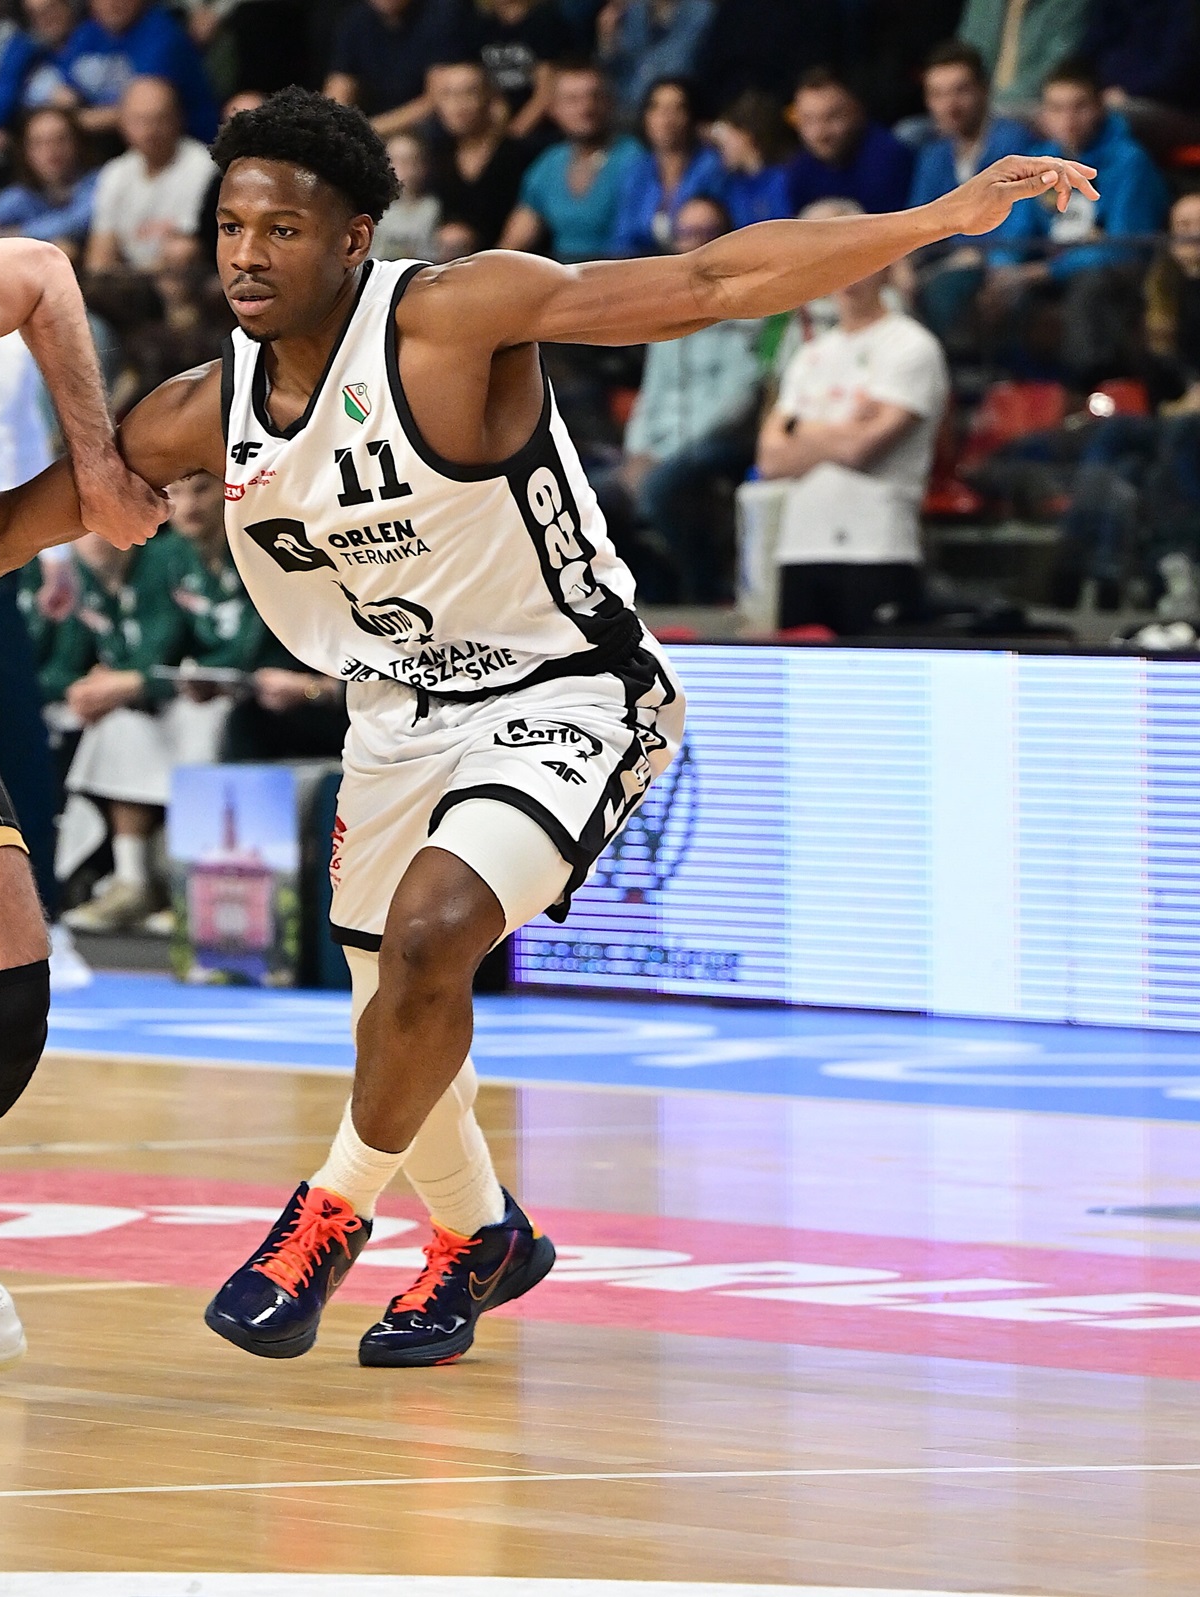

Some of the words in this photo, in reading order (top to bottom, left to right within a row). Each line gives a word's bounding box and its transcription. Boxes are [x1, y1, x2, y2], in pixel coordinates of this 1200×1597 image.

[334, 439, 413, 507] 11
[328, 519, 417, 549] ORLEN
[339, 538, 431, 566] TERMIKA
[367, 609, 413, 636] OTTO
[409, 648, 518, 690] RSZSKIE
